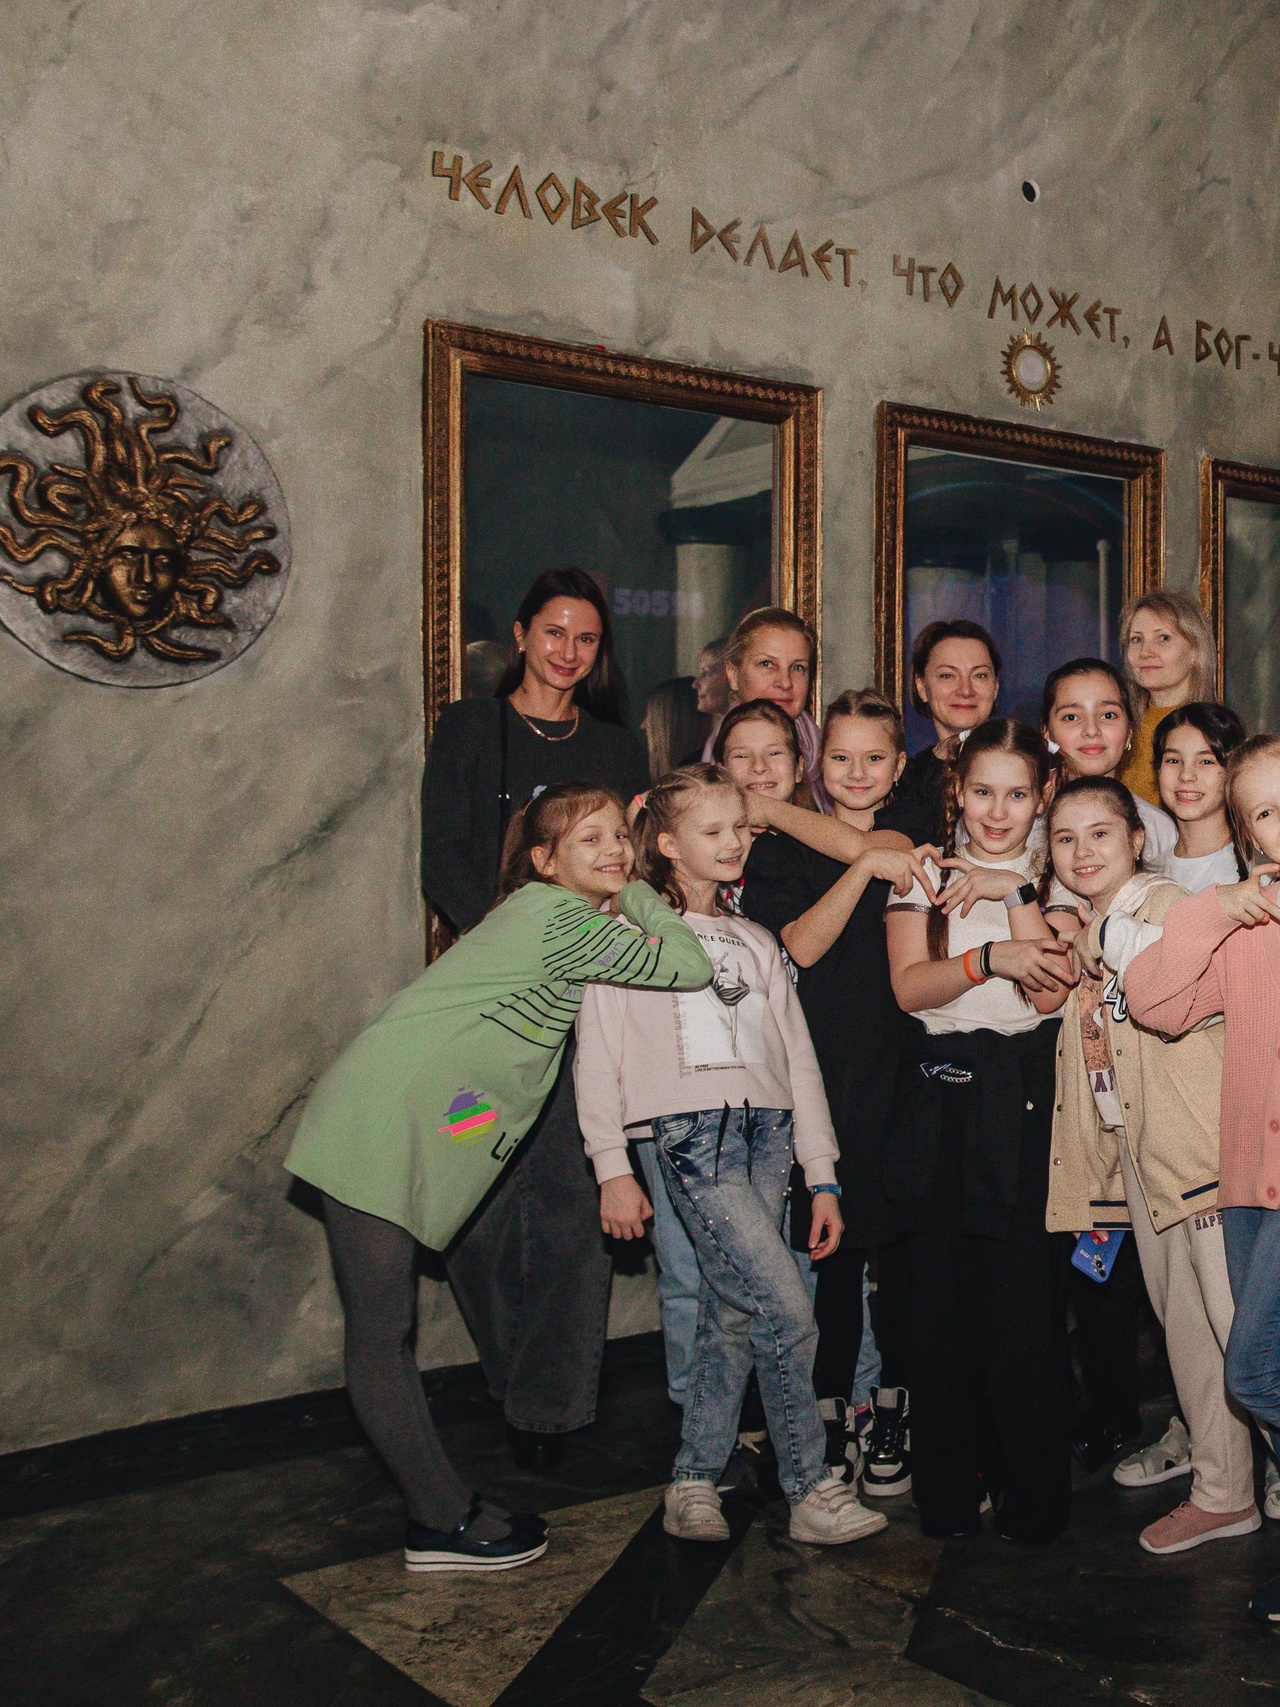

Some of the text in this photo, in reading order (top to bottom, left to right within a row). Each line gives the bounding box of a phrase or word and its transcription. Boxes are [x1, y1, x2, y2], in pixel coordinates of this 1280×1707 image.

[431, 150, 659, 245] ЧЕЛОВЕК
[892, 253, 965, 308] ЧТО
[987, 275, 1132, 347] МОЖЕТ,
[1151, 315, 1175, 356] А
[697, 933, 717, 942] NCE
[565, 988, 583, 999] Lik
[1194, 1214, 1223, 1231] HAPP
